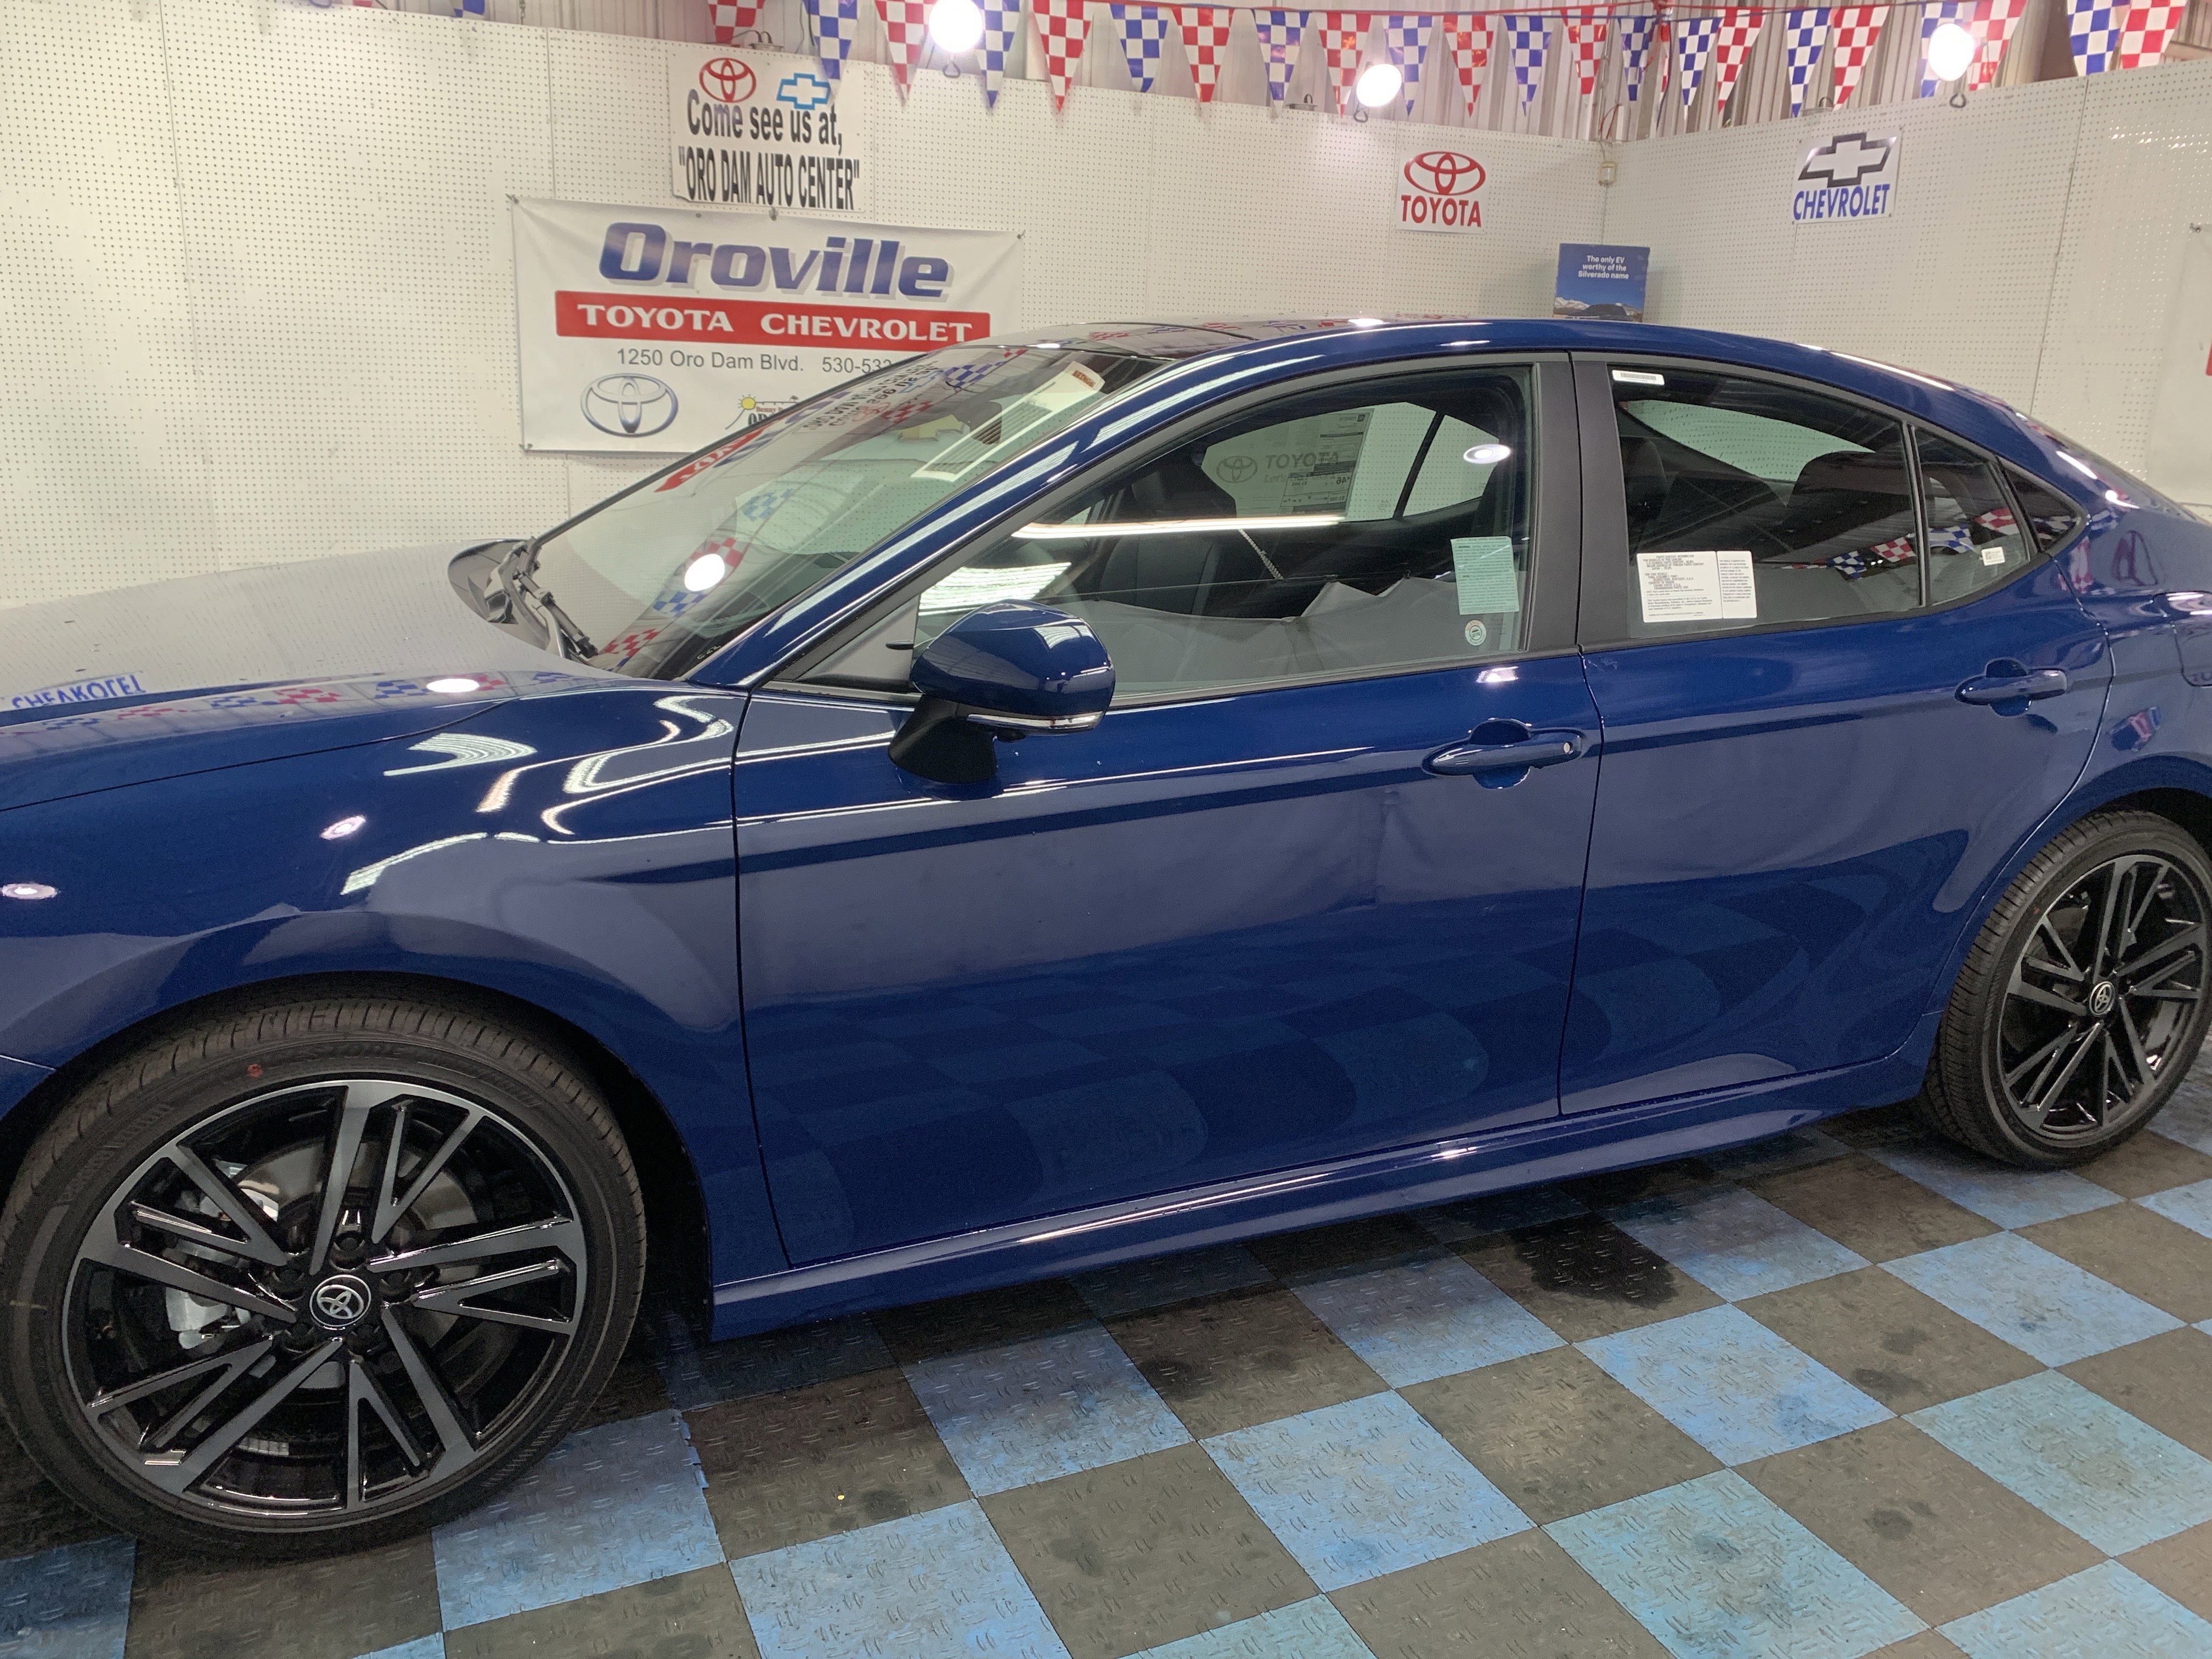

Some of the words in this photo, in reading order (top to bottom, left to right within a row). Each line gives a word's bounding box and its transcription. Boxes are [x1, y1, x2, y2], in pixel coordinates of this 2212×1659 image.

[687, 88, 743, 139] Come
[749, 106, 783, 141] see
[790, 109, 812, 144] us
[818, 102, 843, 156] at,
[678, 145, 716, 202] "ORO
[720, 149, 752, 204] DAM
[755, 151, 793, 207] AUTO
[798, 154, 860, 211] CENTER"
[1401, 194, 1482, 228] TOYOTA
[1793, 183, 1891, 221] CHEVROLET
[599, 221, 952, 302] Oroville
[1578, 270, 1610, 278] Silverado
[1582, 263, 1607, 272] worthy
[1600, 256, 1615, 264] only
[577, 303, 734, 333] TOYOTA
[760, 312, 973, 343] CHEVROLET
[617, 348, 663, 366] 1250
[670, 349, 704, 368] Oro
[711, 352, 754, 369] Dam
[760, 353, 804, 372] Blvd.
